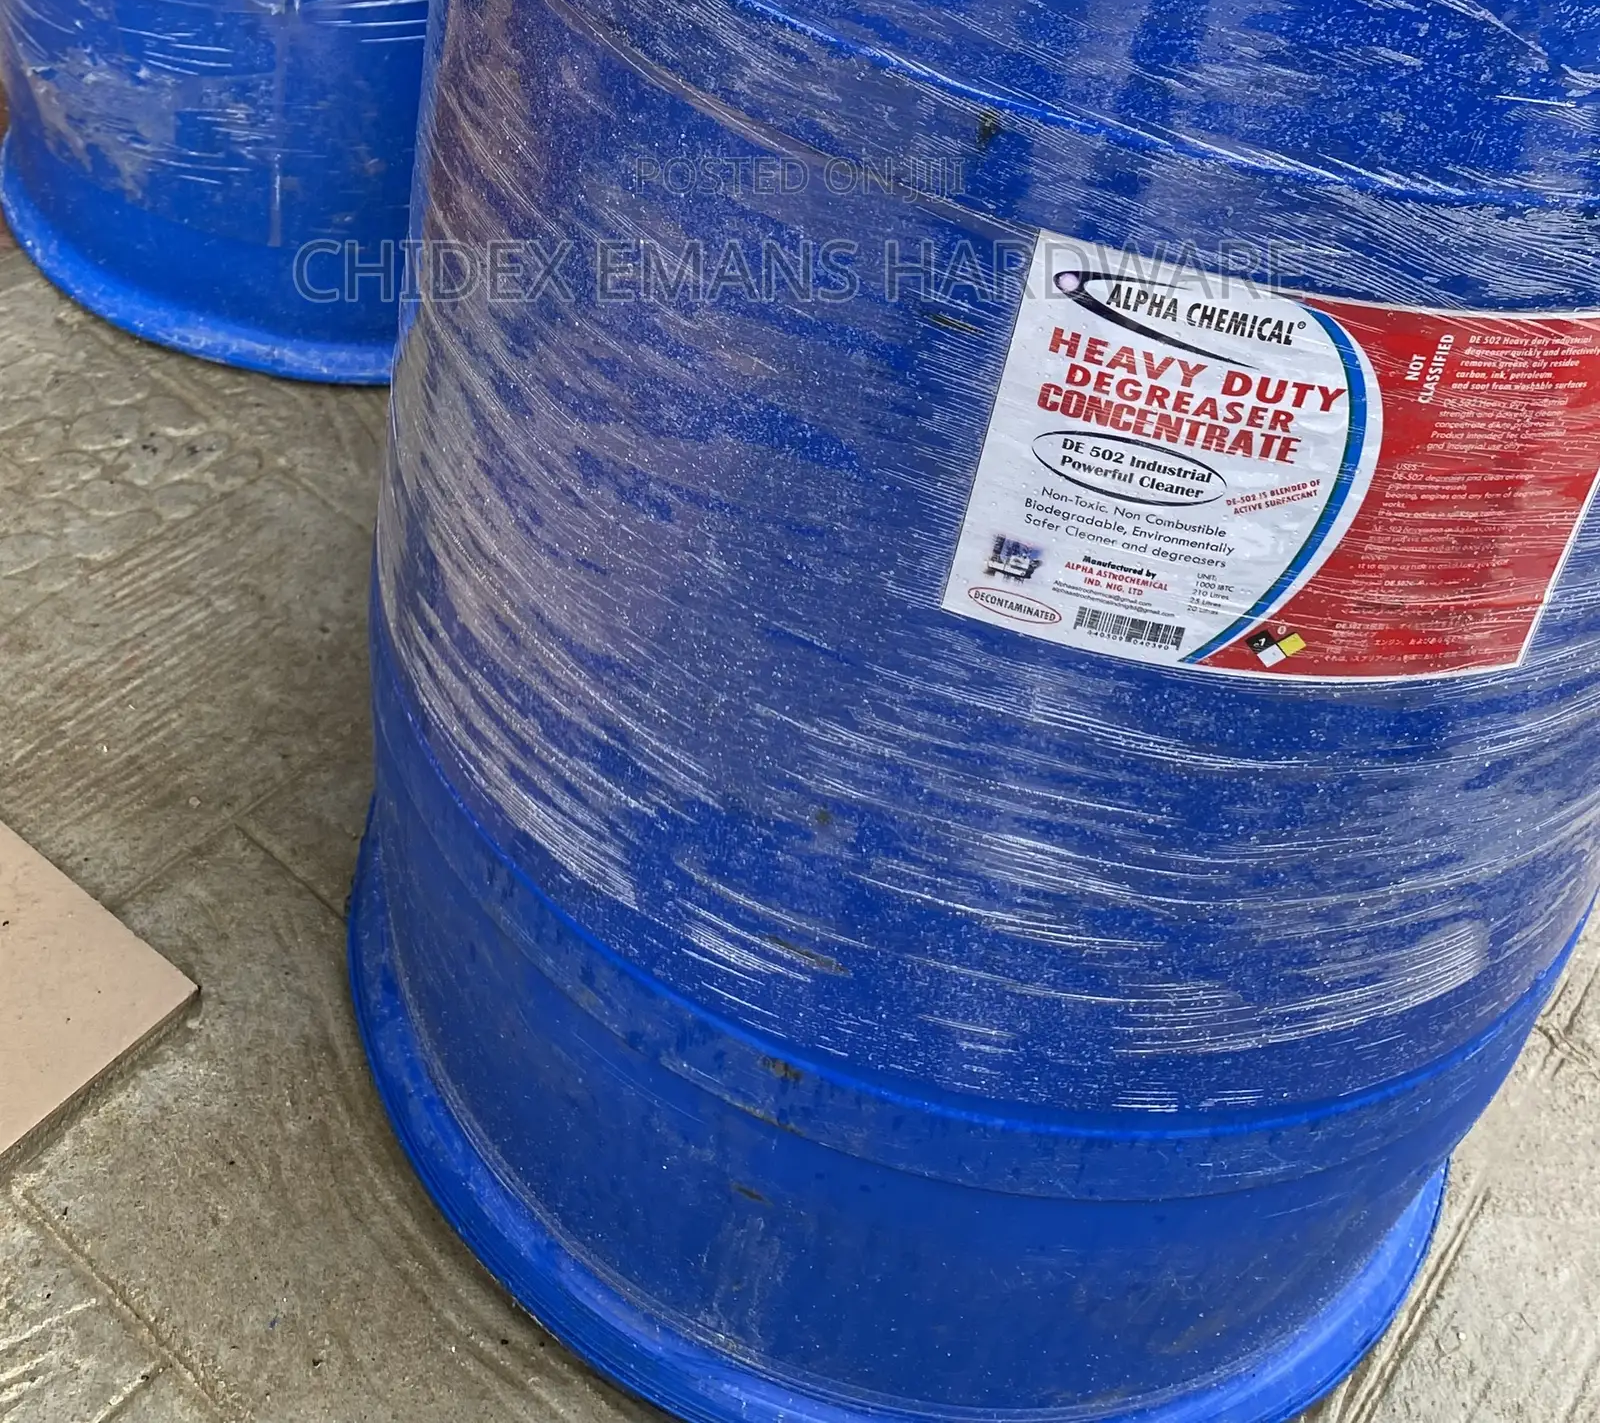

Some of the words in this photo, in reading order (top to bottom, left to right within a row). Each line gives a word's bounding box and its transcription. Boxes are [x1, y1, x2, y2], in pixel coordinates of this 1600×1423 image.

[1106, 283, 1180, 322] ALPHA
[1469, 335, 1481, 344] DE
[1483, 336, 1501, 345] 502
[1503, 336, 1529, 346] Heavy
[1531, 335, 1550, 345] duty
[1511, 347, 1541, 358] quickly
[1543, 348, 1559, 356] and
[1049, 326, 1208, 387] HEAVY
[1221, 370, 1347, 412] DUTY
[1405, 354, 1426, 381] NOT
[1418, 334, 1454, 404] CLASSIFIED
[1532, 359, 1548, 370] oily
[1550, 359, 1580, 367] residue
[1065, 363, 1295, 433] DEGREASER
[1452, 382, 1469, 390] and
[1471, 382, 1490, 390] soot
[1492, 381, 1512, 390] from
[1555, 381, 1587, 389] surfaces
[1037, 383, 1302, 464] CONCENTRATE
[1431, 431, 1464, 439] Product
[1062, 438, 1084, 454] DE
[1089, 446, 1125, 465] 502
[1130, 456, 1212, 483] Industrial
[1060, 455, 1135, 483] Powerful
[1139, 475, 1204, 499] Cleaner
[1226, 495, 1256, 507] DE-502
[1259, 492, 1267, 500] IS
[1270, 483, 1308, 498] BLENDED
[1310, 479, 1321, 489] OF
[1233, 502, 1265, 515] ACTIVE
[1265, 489, 1319, 507] SURFACTANT
[1421, 492, 1450, 500] engines
[1451, 492, 1466, 500] and
[1503, 490, 1512, 498] of
[1024, 498, 1128, 537] Biodegradable,
[1132, 526, 1236, 557] Environmentally
[1114, 505, 1141, 521] Non
[1145, 513, 1227, 538] Combustible
[1024, 513, 1061, 533] Safer
[1065, 525, 1117, 547] Cleaner
[1122, 538, 1147, 554] and
[1151, 546, 1227, 570] degreasers
[1064, 561, 1094, 575] ALPHA
[1096, 568, 1169, 591] ASTROCHEMICAL
[1082, 555, 1143, 577] Manufactured
[1145, 569, 1157, 580] by
[1084, 577, 1104, 588] IND.
[1105, 581, 1125, 593] NIG.
[1128, 585, 1144, 596] LTD
[1191, 588, 1208, 598] 210
[1195, 581, 1216, 591] 1000
[973, 590, 1056, 622] DECONTAMINATED
[1188, 596, 1201, 605] 25
